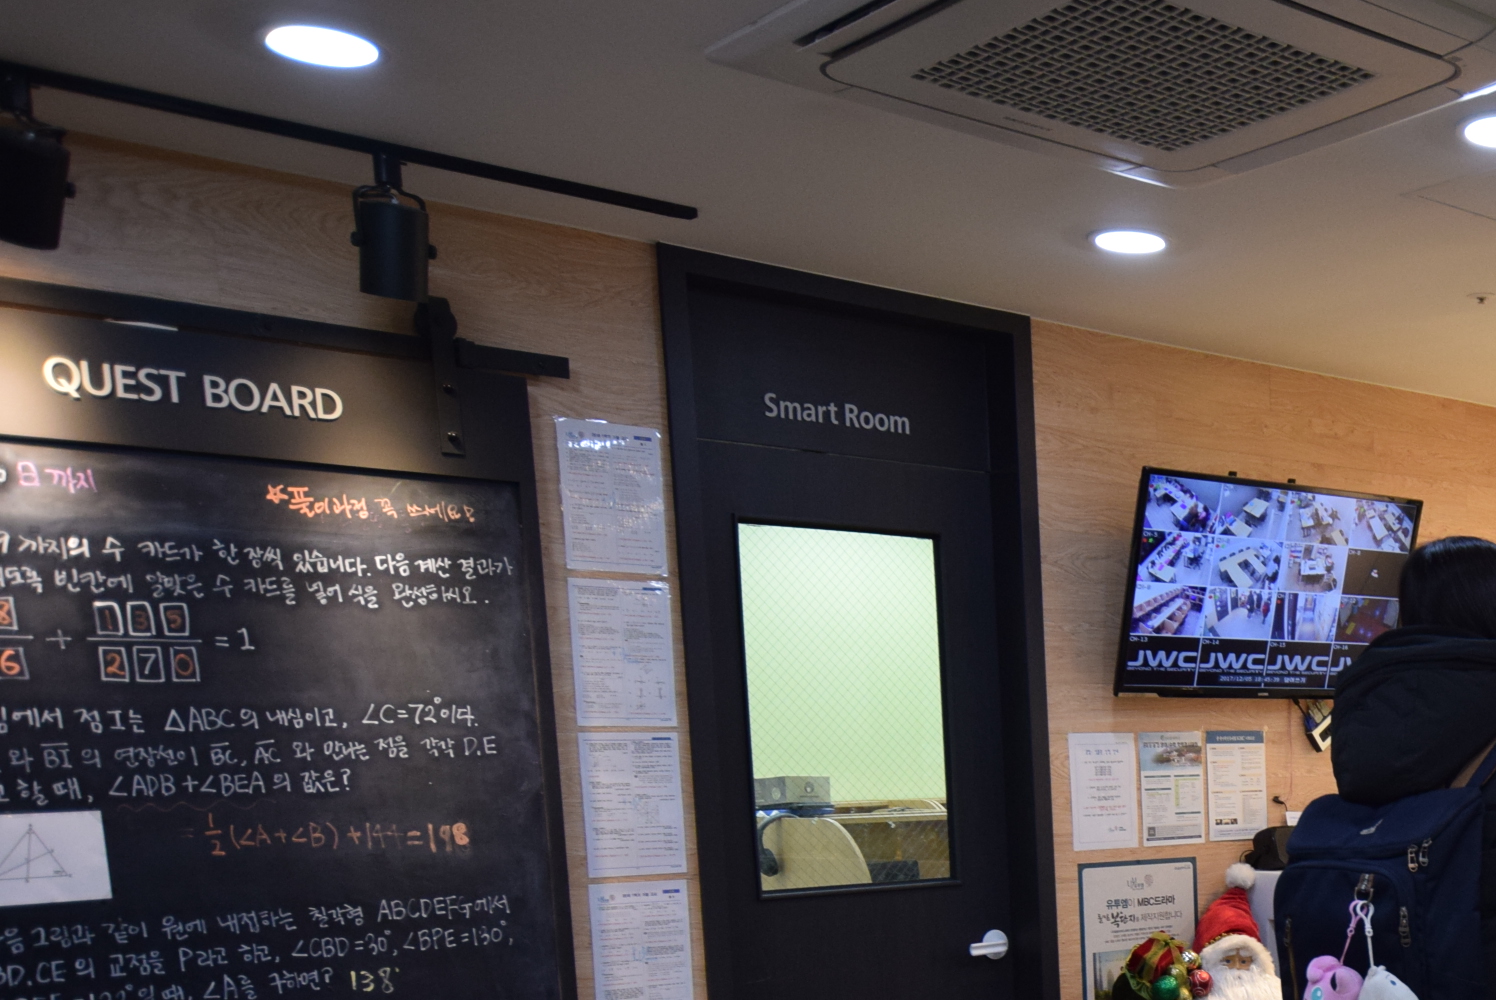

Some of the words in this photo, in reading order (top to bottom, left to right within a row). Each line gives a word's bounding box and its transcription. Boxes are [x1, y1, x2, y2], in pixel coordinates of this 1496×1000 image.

[42, 355, 187, 402] QUEST
[203, 374, 344, 422] BOARD
[763, 392, 840, 426] Smart
[843, 403, 911, 436] Room
[102, 536, 126, 562] 수
[138, 541, 203, 562] 카드가
[293, 549, 372, 577] 있습니다.
[374, 552, 410, 577] 다음
[414, 557, 451, 579] 계산
[53, 568, 134, 594] 빈칸에
[212, 574, 234, 598] 수
[1127, 649, 1198, 668] JWC
[1199, 652, 1266, 670] JWC
[1267, 654, 1329, 672] JWC
